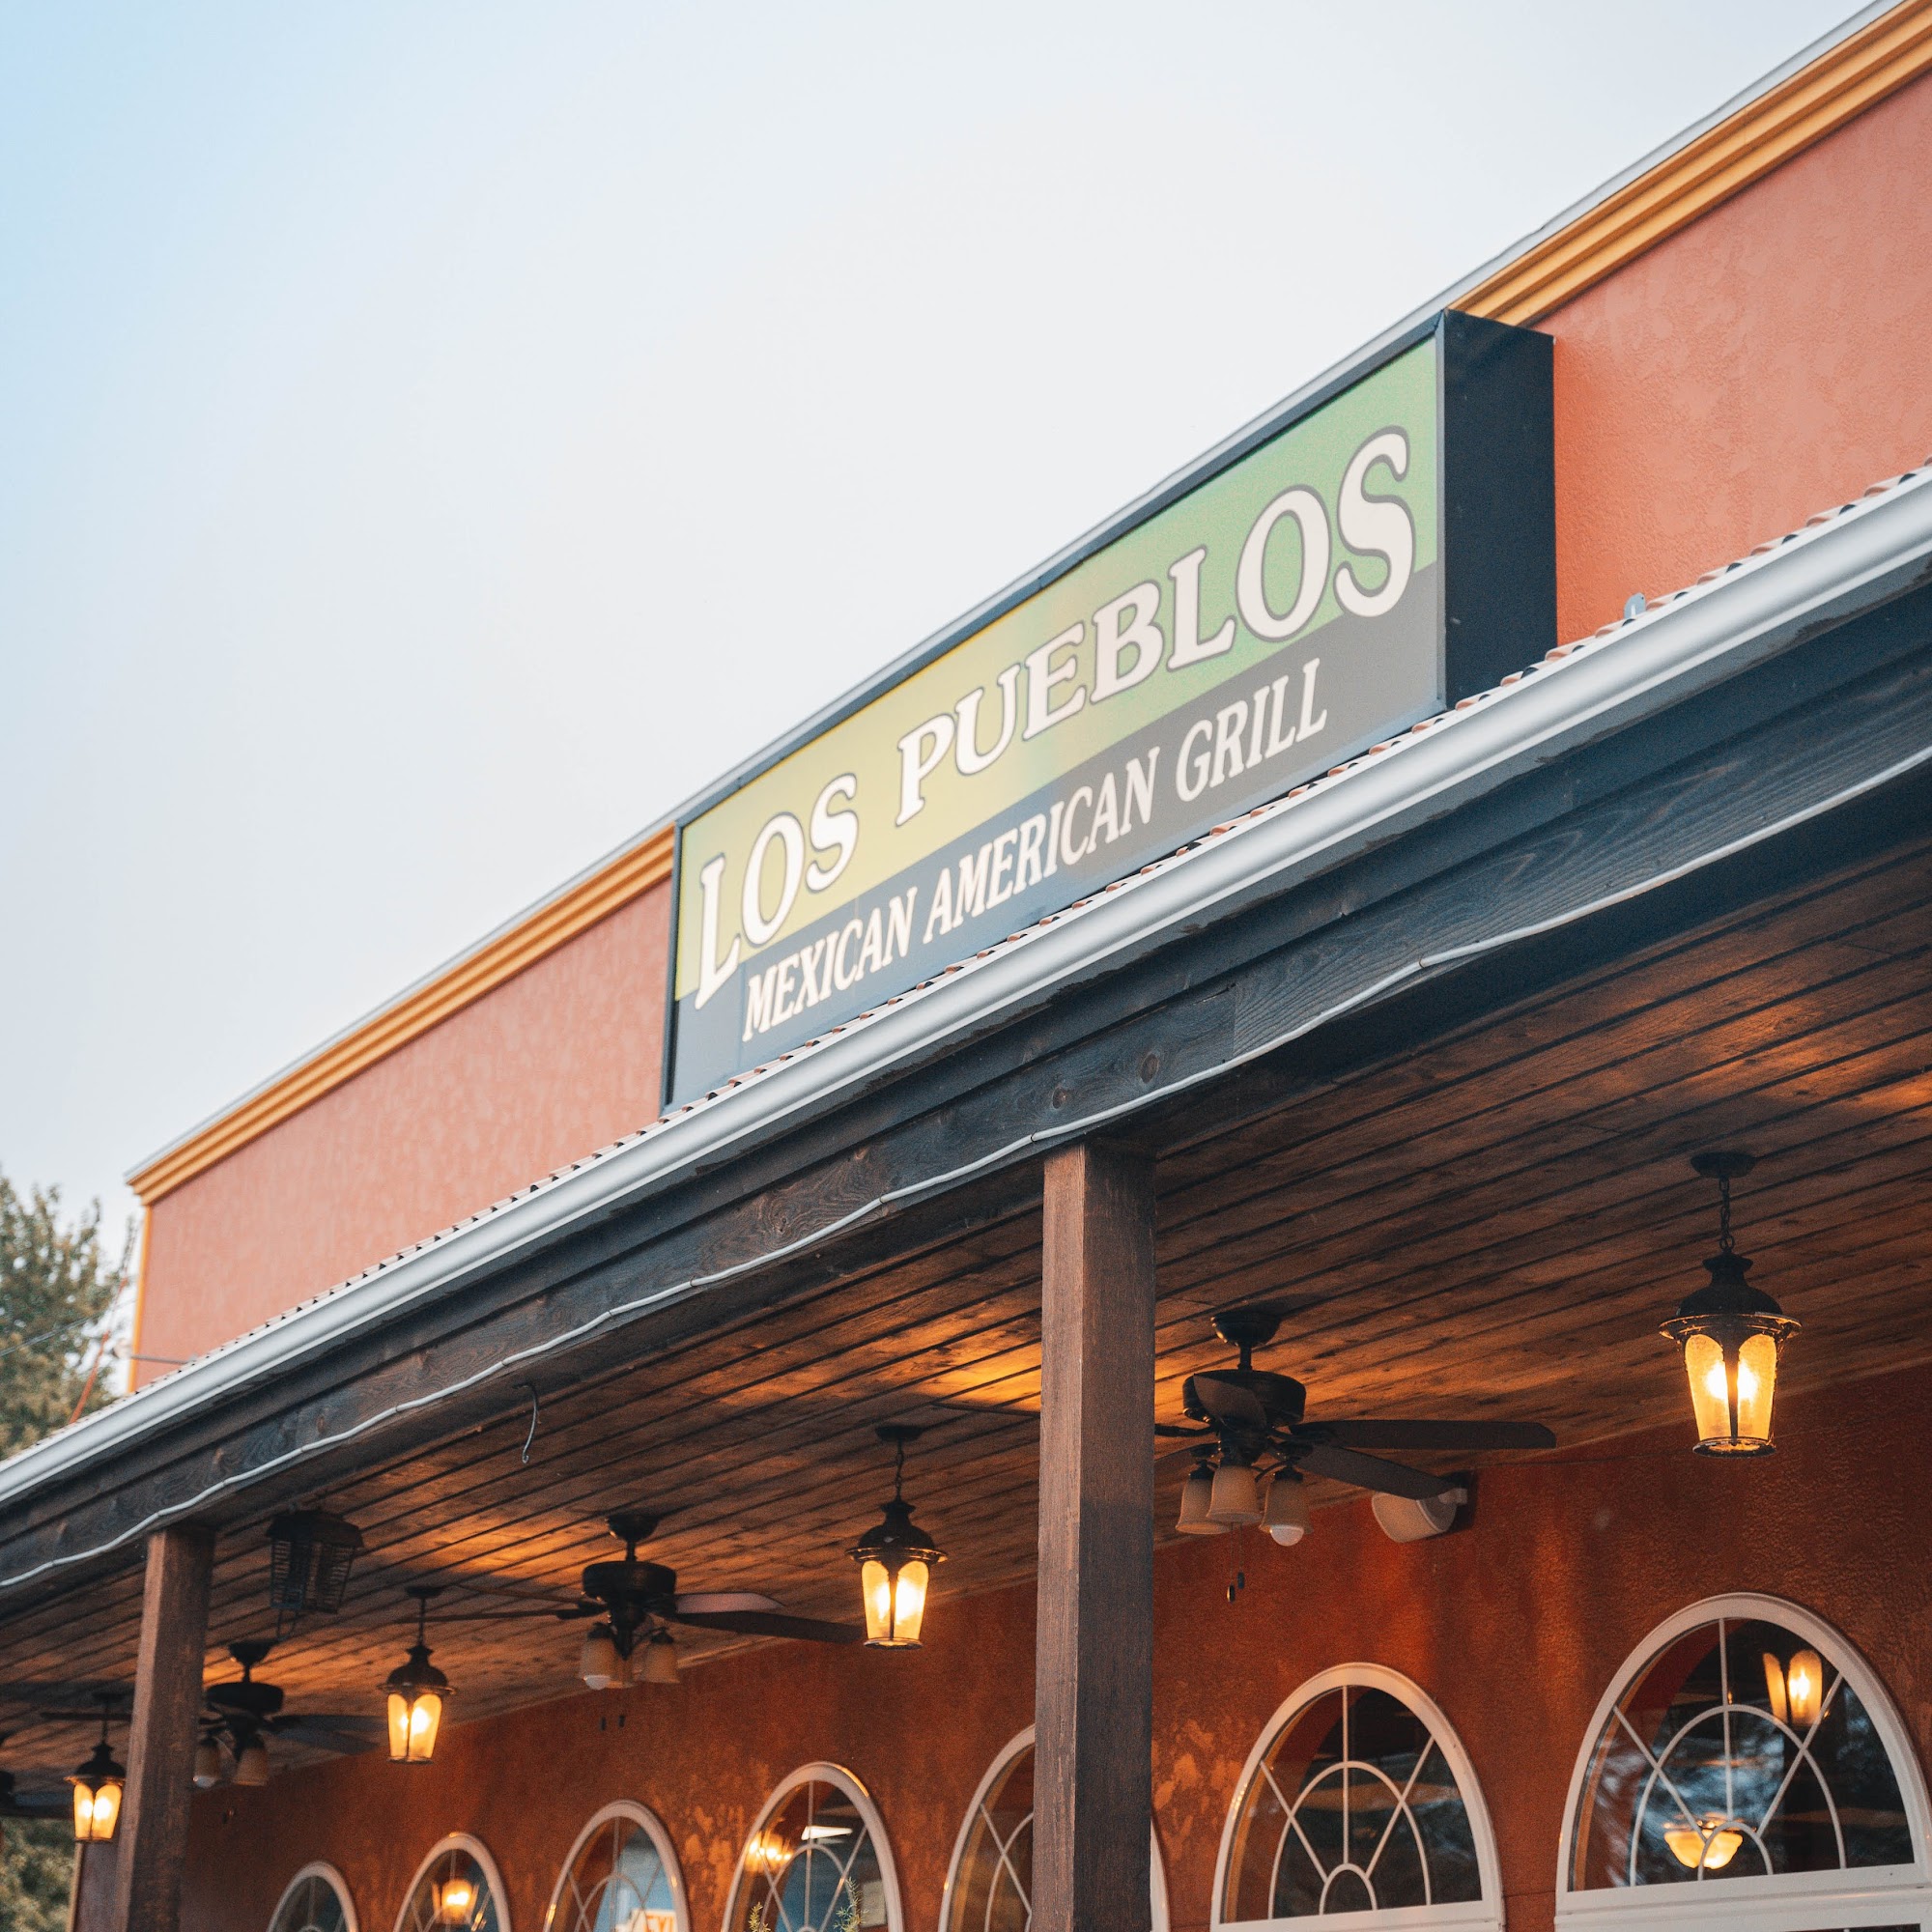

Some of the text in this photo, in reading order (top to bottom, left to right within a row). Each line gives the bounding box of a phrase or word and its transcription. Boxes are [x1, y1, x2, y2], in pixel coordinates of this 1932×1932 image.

[695, 425, 1416, 1009] LOS PUEBLOS
[742, 658, 1327, 1042] MEXICAN AMERICAN GRILL
